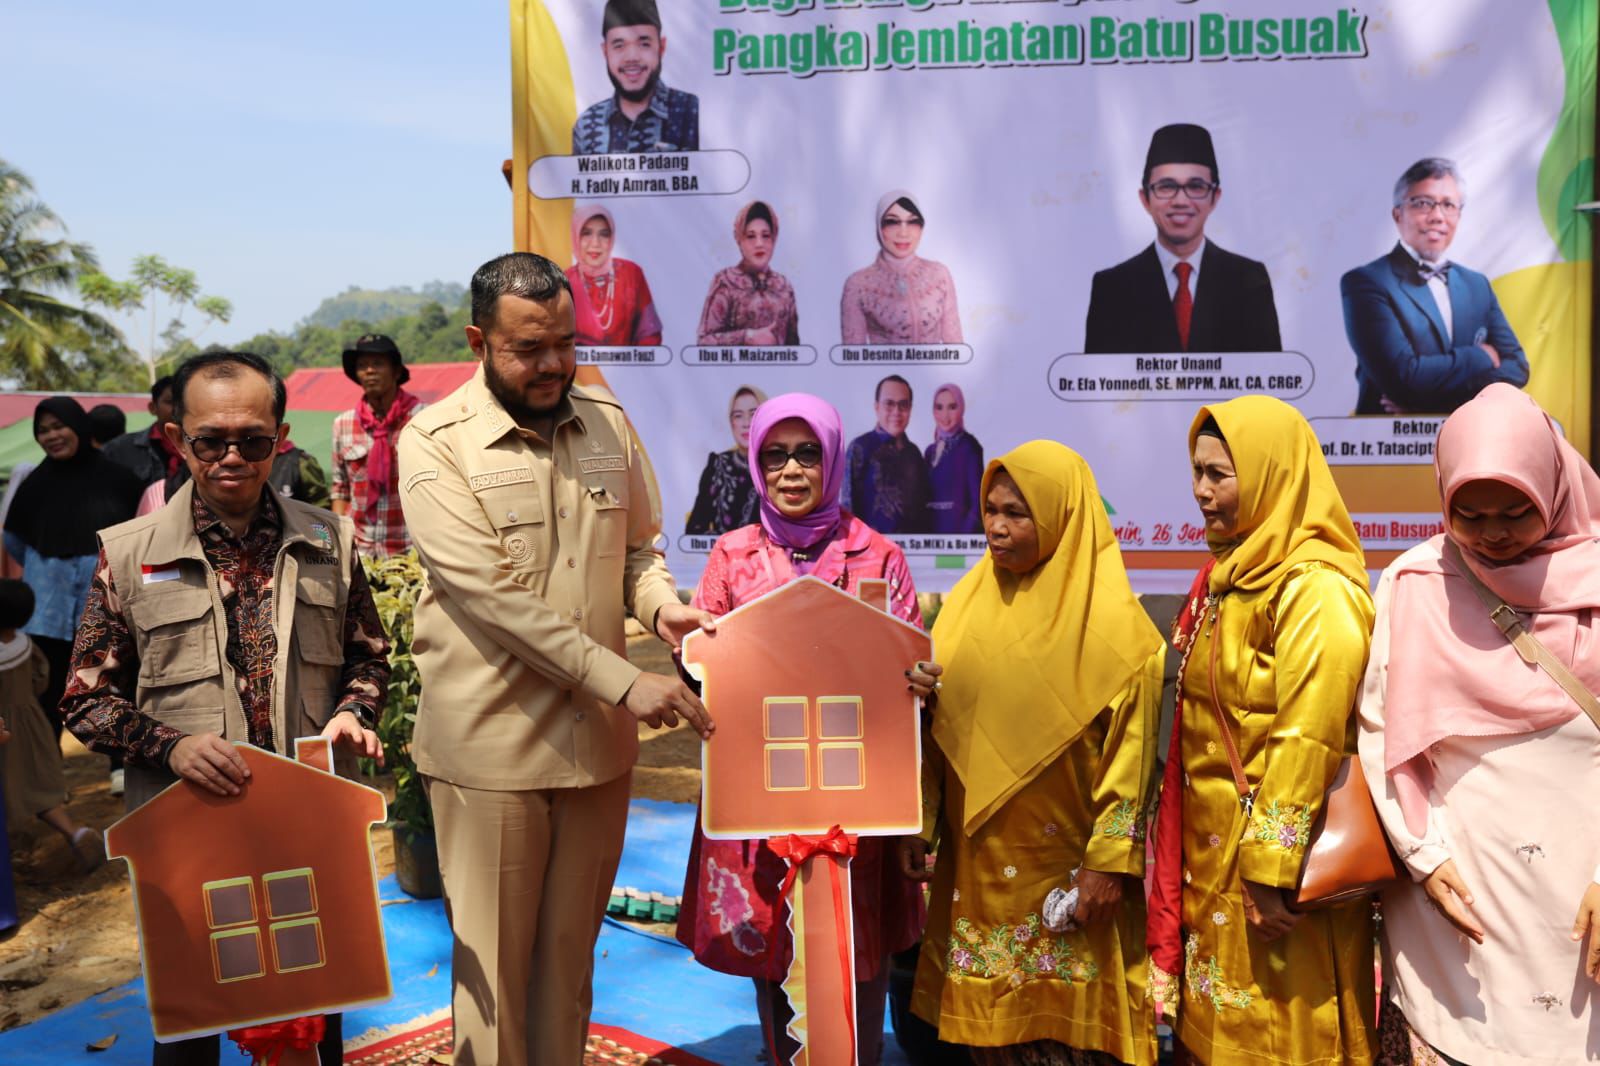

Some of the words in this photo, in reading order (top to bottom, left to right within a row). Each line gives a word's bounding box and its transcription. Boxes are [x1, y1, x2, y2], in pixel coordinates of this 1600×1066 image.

[713, 24, 867, 76] Pangka
[873, 20, 1084, 72] Jembatan
[1090, 16, 1193, 64] Batu
[1200, 9, 1366, 61] Busuak
[578, 156, 636, 172] Walikota
[639, 155, 689, 171] Padang
[572, 179, 583, 193] H.
[586, 178, 620, 193] Fadly
[672, 176, 699, 191] BBA
[699, 349, 718, 361] Ibu
[721, 349, 736, 362] Hj.
[739, 348, 798, 361] Maizarnis
[842, 349, 860, 361] Ibu
[862, 348, 902, 361] Desnita
[905, 347, 960, 360] Alexandra
[1136, 357, 1178, 371] Rektor
[1181, 356, 1222, 371] Unand
[1059, 377, 1075, 391] Dr.
[1077, 377, 1096, 391] Efa
[1393, 420, 1439, 435] Rektor
[1321, 441, 1338, 457] of.
[1341, 441, 1358, 456] Dr.
[1361, 441, 1374, 456] Ir.
[1377, 441, 1435, 457] Tatacipt
[472, 474, 498, 489] FADLY
[1114, 521, 1144, 546] nin,
[1151, 523, 1172, 545] 26
[1177, 522, 1207, 545] Jan
[1353, 521, 1387, 539] Batu
[690, 538, 708, 549] Ibu
[305, 556, 339, 566] UNAND
